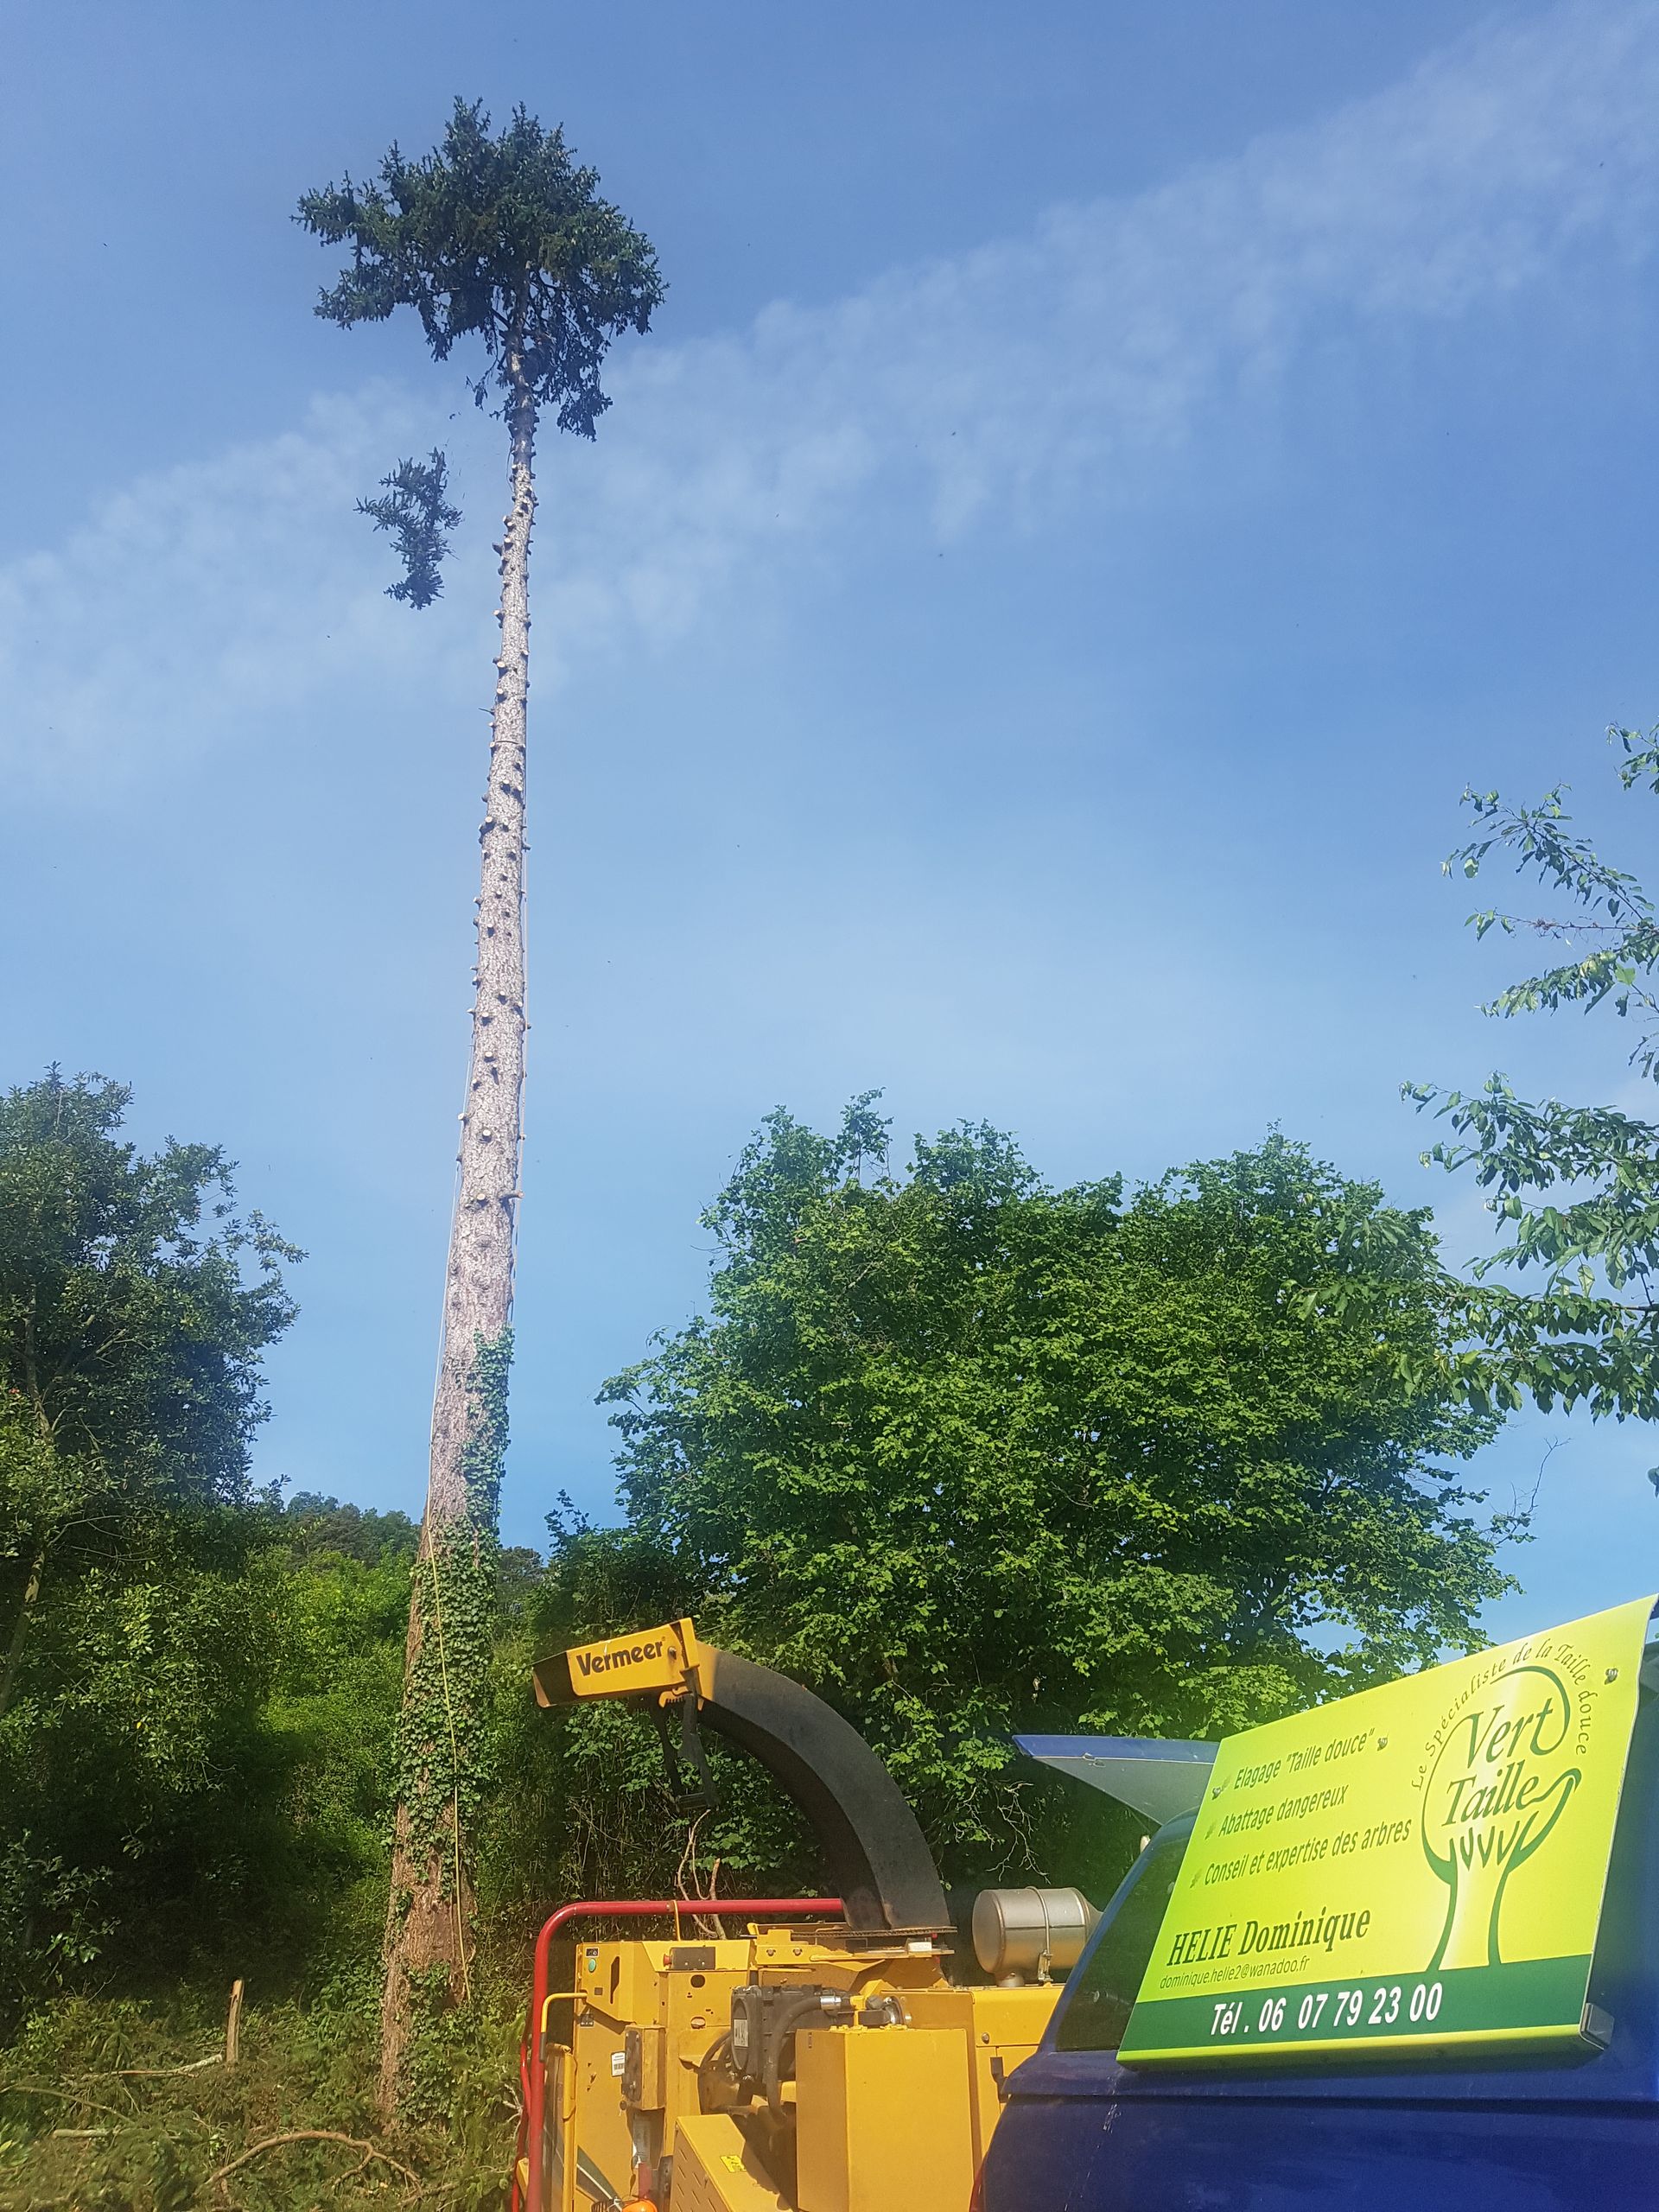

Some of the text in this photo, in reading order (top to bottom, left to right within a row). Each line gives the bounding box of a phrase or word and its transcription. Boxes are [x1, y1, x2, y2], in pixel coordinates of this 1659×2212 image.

[575, 1640, 664, 1677] Vermeer
[1425, 1656, 1507, 1758] Spécialiste
[1512, 1642, 1531, 1666] de
[1554, 1643, 1591, 1687] Taille
[1575, 1689, 1599, 1756] douce
[1465, 1697, 1554, 1770] Vert
[1234, 1758, 1281, 1790] Elagage
[1440, 1758, 1545, 1827] Taille
[1218, 1783, 1350, 1838] Abattage dangereux
[1205, 1818, 1412, 1886] Conseil et expertise des arbres
[1166, 1906, 1371, 1967] HELIE Dominique
[1258, 1997, 1287, 2033] 06
[1297, 1993, 1329, 2031] 07
[1333, 1989, 1363, 2028] 79
[1367, 1986, 1402, 2025] 23
[1408, 1982, 1443, 2023] 00
